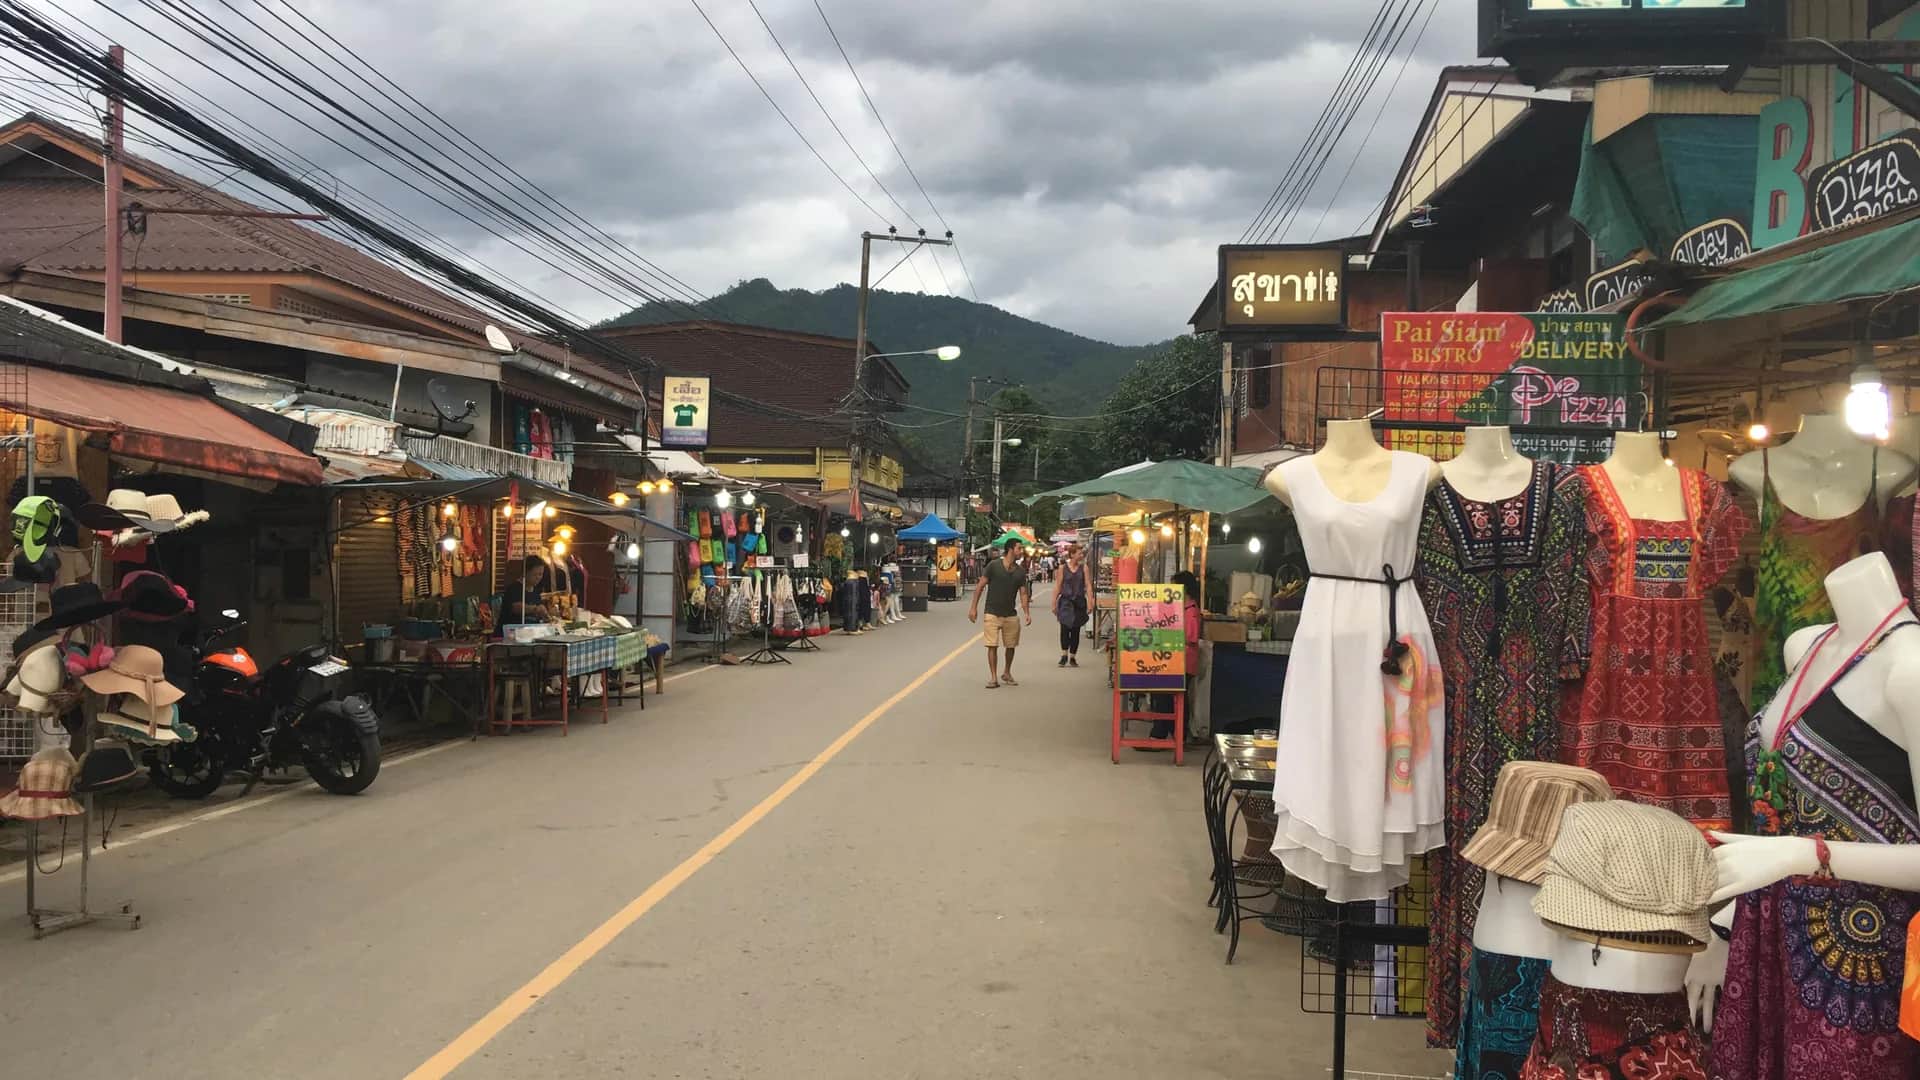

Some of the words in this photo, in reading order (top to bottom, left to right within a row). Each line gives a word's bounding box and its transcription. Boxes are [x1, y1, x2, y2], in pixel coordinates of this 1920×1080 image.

[1822, 150, 1911, 227] Pizza
[1696, 226, 1728, 263] day
[1232, 271, 1302, 318] สุขา
[1393, 320, 1432, 342] Pai
[1441, 320, 1503, 342] Siam
[1411, 347, 1482, 363] BISTRO
[1120, 585, 1157, 599] Mixed
[1163, 588, 1182, 604] 30
[1121, 603, 1152, 617] Fruit
[1144, 613, 1179, 628] Shake
[1136, 660, 1167, 674] Sugar
